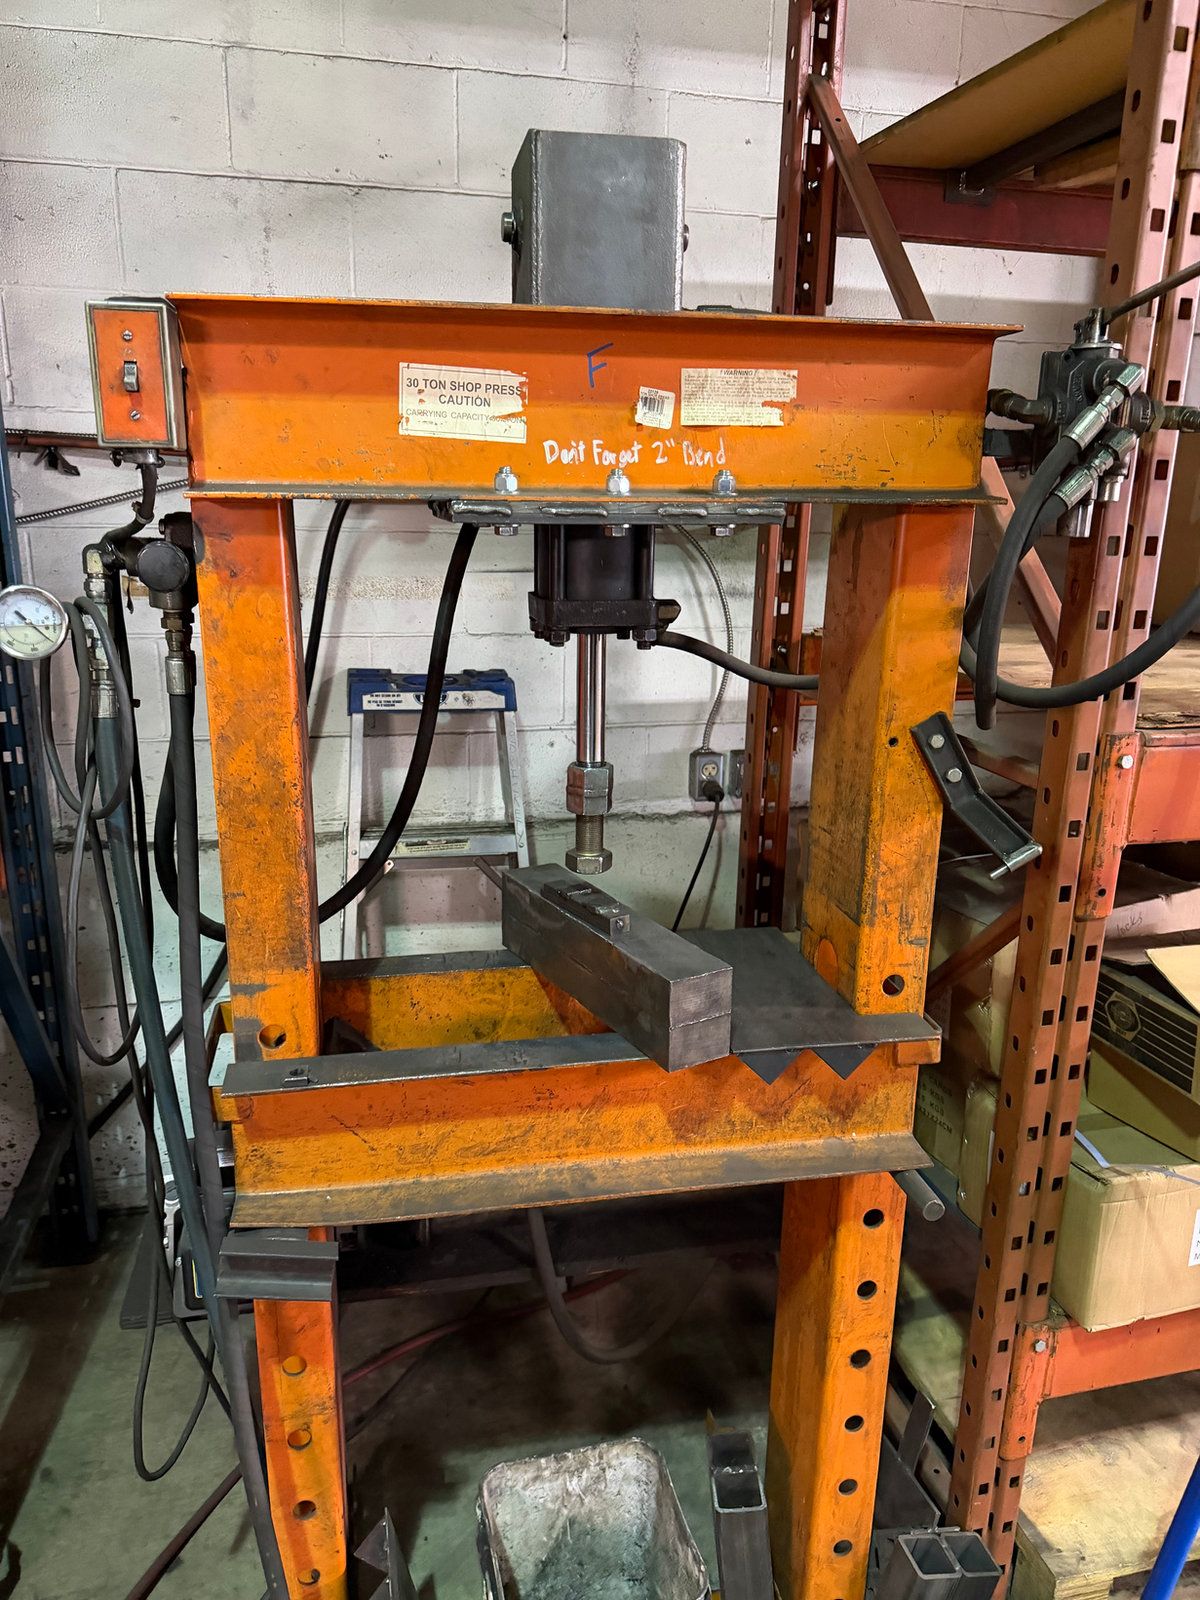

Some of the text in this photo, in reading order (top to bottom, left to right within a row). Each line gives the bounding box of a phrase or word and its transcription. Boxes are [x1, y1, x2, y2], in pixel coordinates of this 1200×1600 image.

[587, 342, 614, 388] F
[406, 377, 522, 397] 30 TON SHOP PRESS
[438, 393, 491, 408] CAUTION
[405, 407, 448, 419] CARRYING
[592, 439, 643, 468] Forget
[682, 437, 727, 468] Bend
